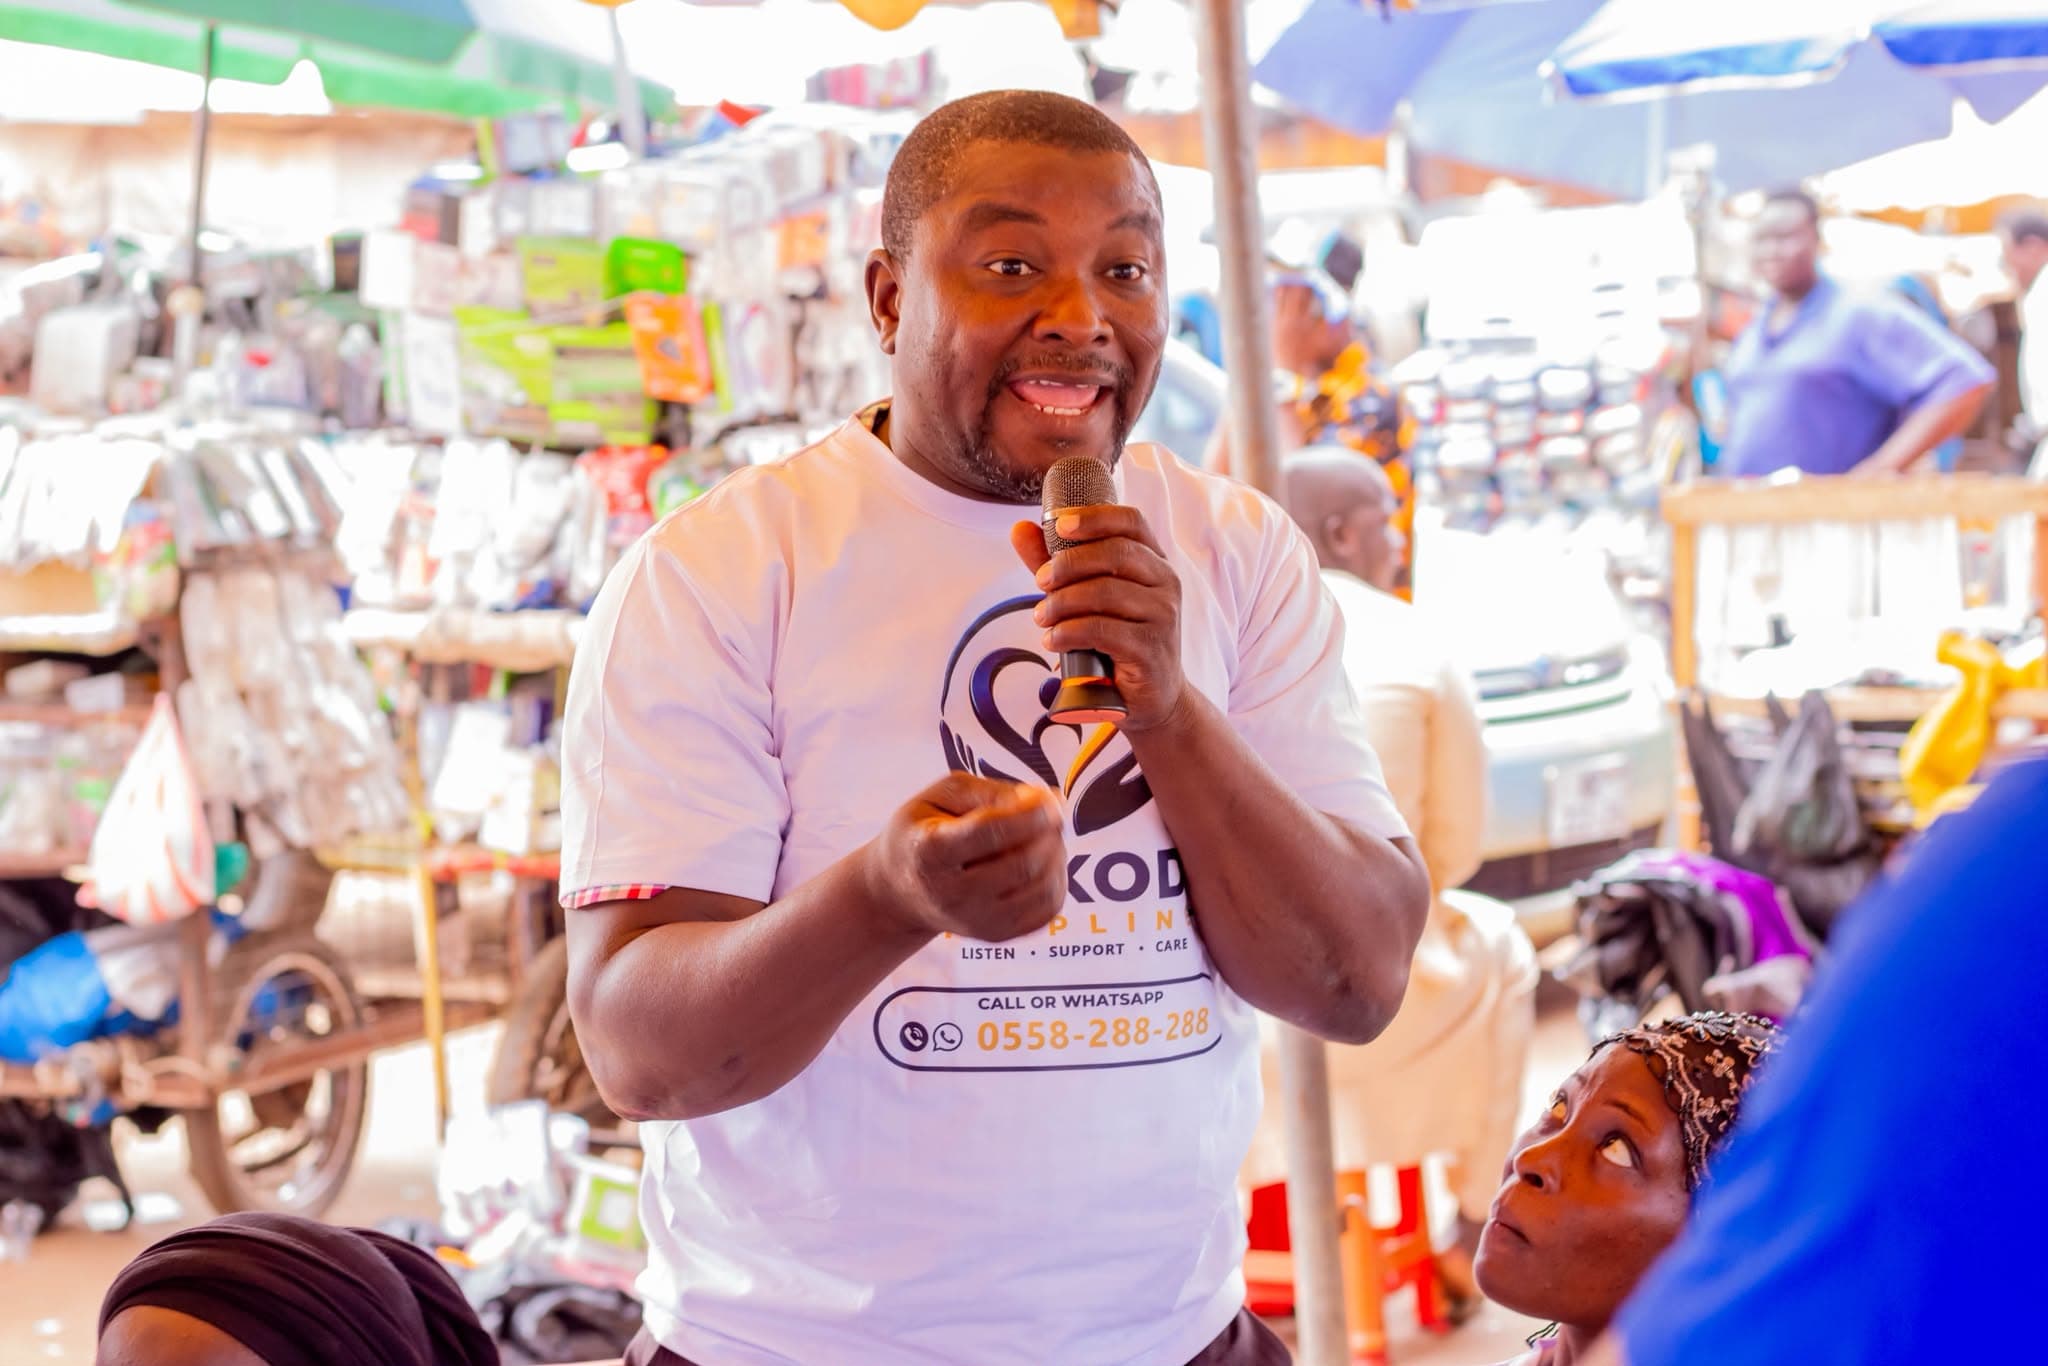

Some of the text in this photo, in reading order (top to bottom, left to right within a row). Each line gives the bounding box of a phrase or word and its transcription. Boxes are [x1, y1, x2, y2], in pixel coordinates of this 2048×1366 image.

[1067, 848, 1186, 903] KOD
[962, 938, 1188, 960] LISTEN SUPPORT CARE
[978, 991, 1164, 1010] CALL OR WHATSAPP
[977, 1007, 1209, 1051] 0558-288-288
